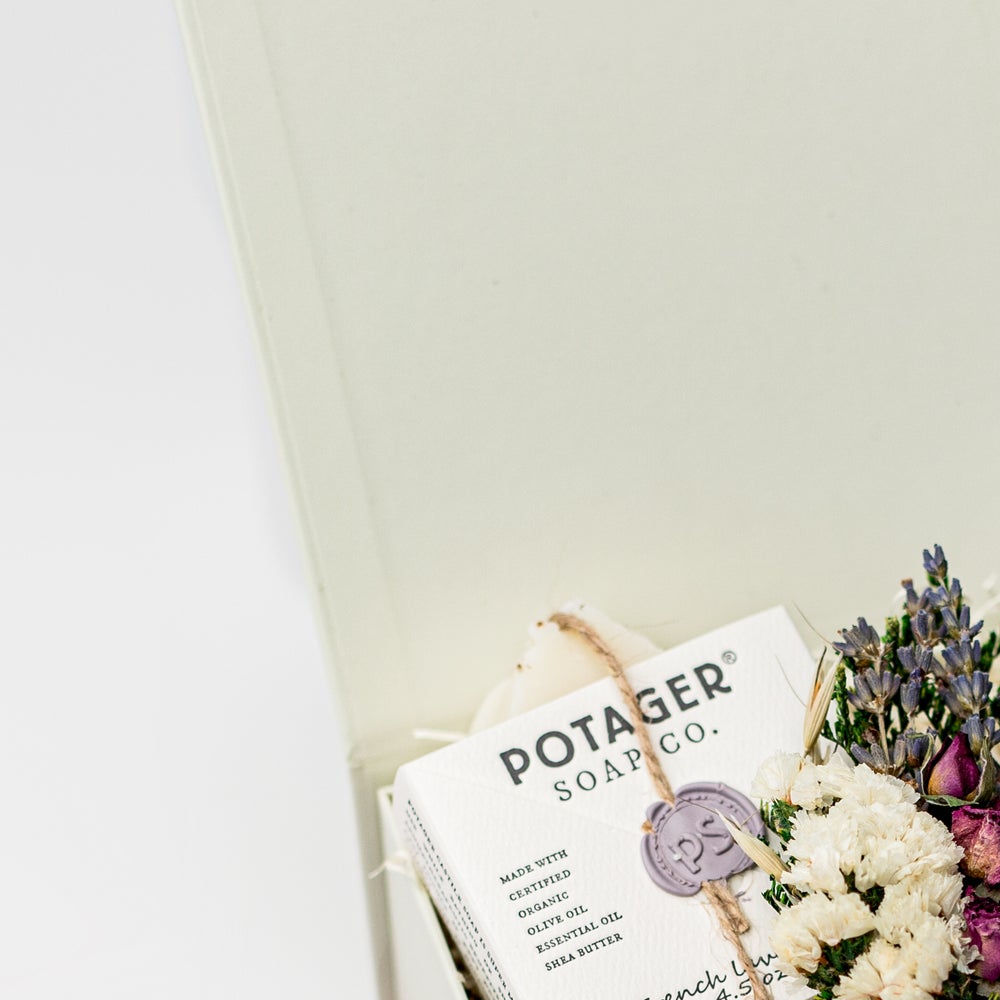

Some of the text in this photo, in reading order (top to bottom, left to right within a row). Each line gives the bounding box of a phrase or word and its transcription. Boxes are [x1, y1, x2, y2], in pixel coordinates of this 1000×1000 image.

[553, 722, 719, 801] SOAP CO.
[668, 815, 736, 875] PS
[499, 849, 568, 885] MADE WITH
[509, 869, 571, 902] CERTIFIED
[518, 891, 569, 919] ORGANIC
[527, 904, 588, 936] OLIVE OIL
[535, 911, 623, 954] ESSENTIAL OIL
[544, 932, 623, 972] SHEA BUTTER
